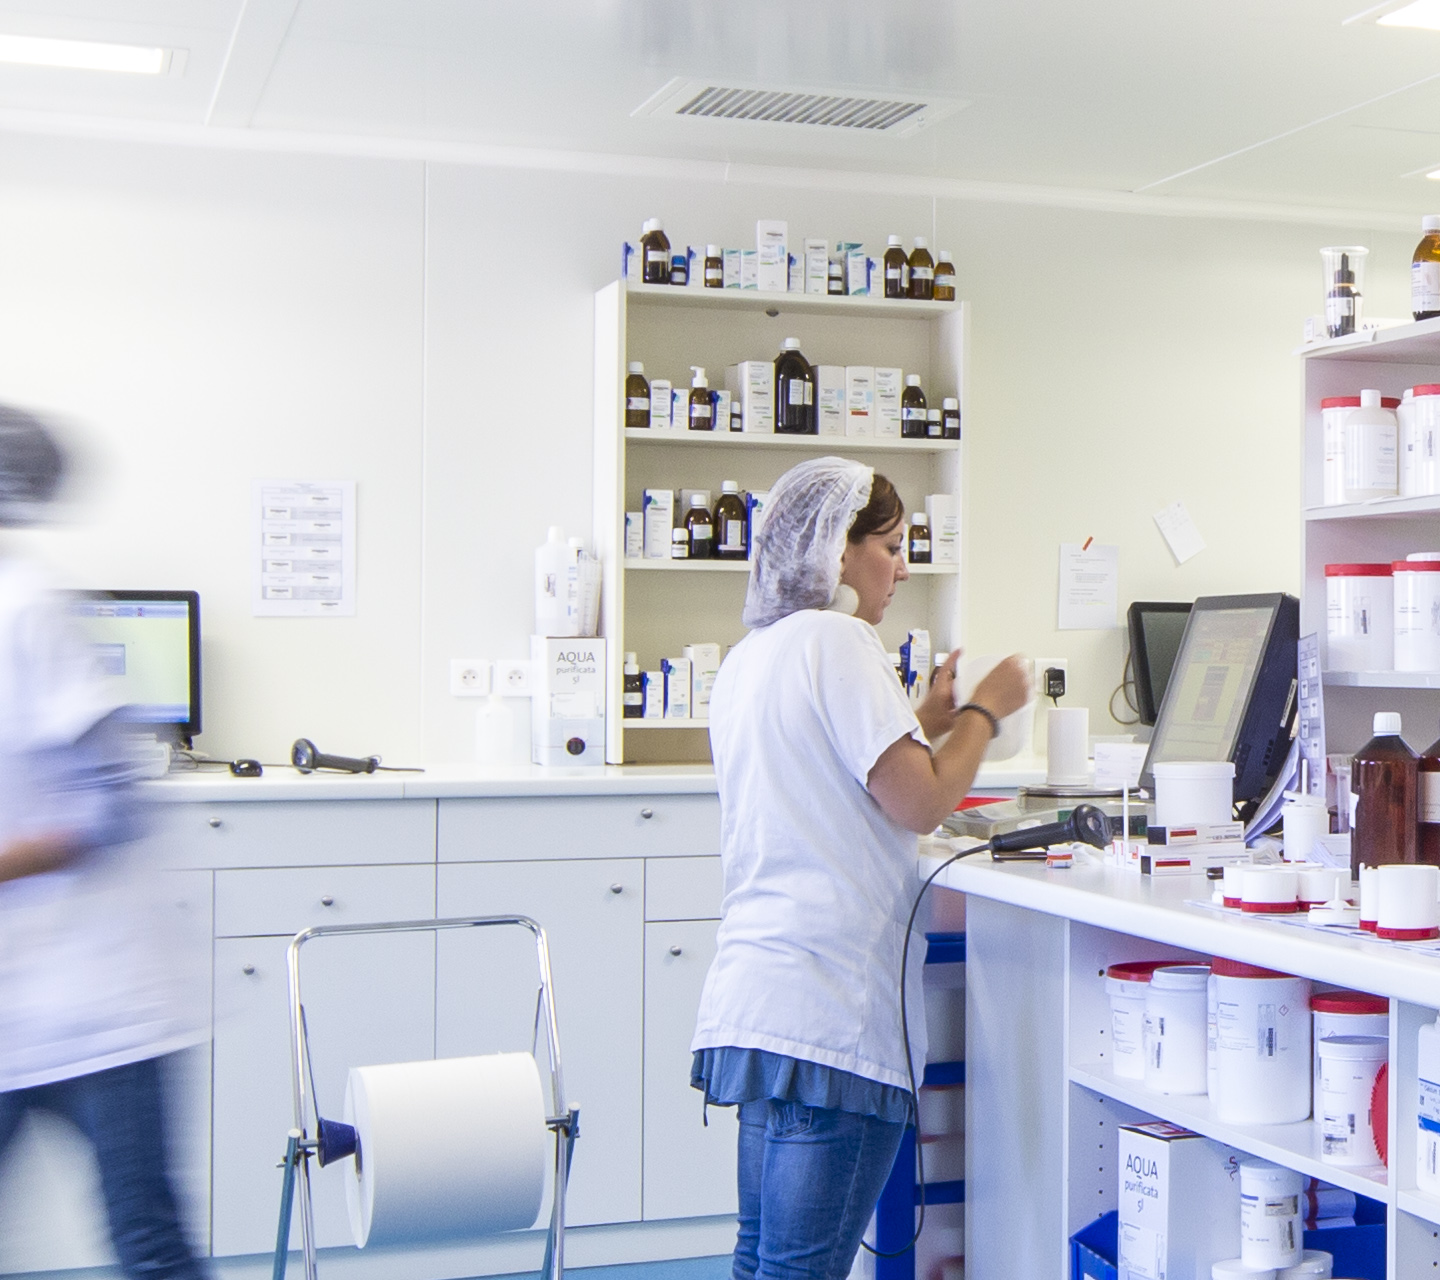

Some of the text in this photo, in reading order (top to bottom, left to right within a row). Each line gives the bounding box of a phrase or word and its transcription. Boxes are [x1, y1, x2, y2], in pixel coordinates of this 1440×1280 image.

[557, 651, 595, 665] AQUA
[1125, 1153, 1159, 1180] AQUA
[1124, 1179, 1159, 1200] purificata
